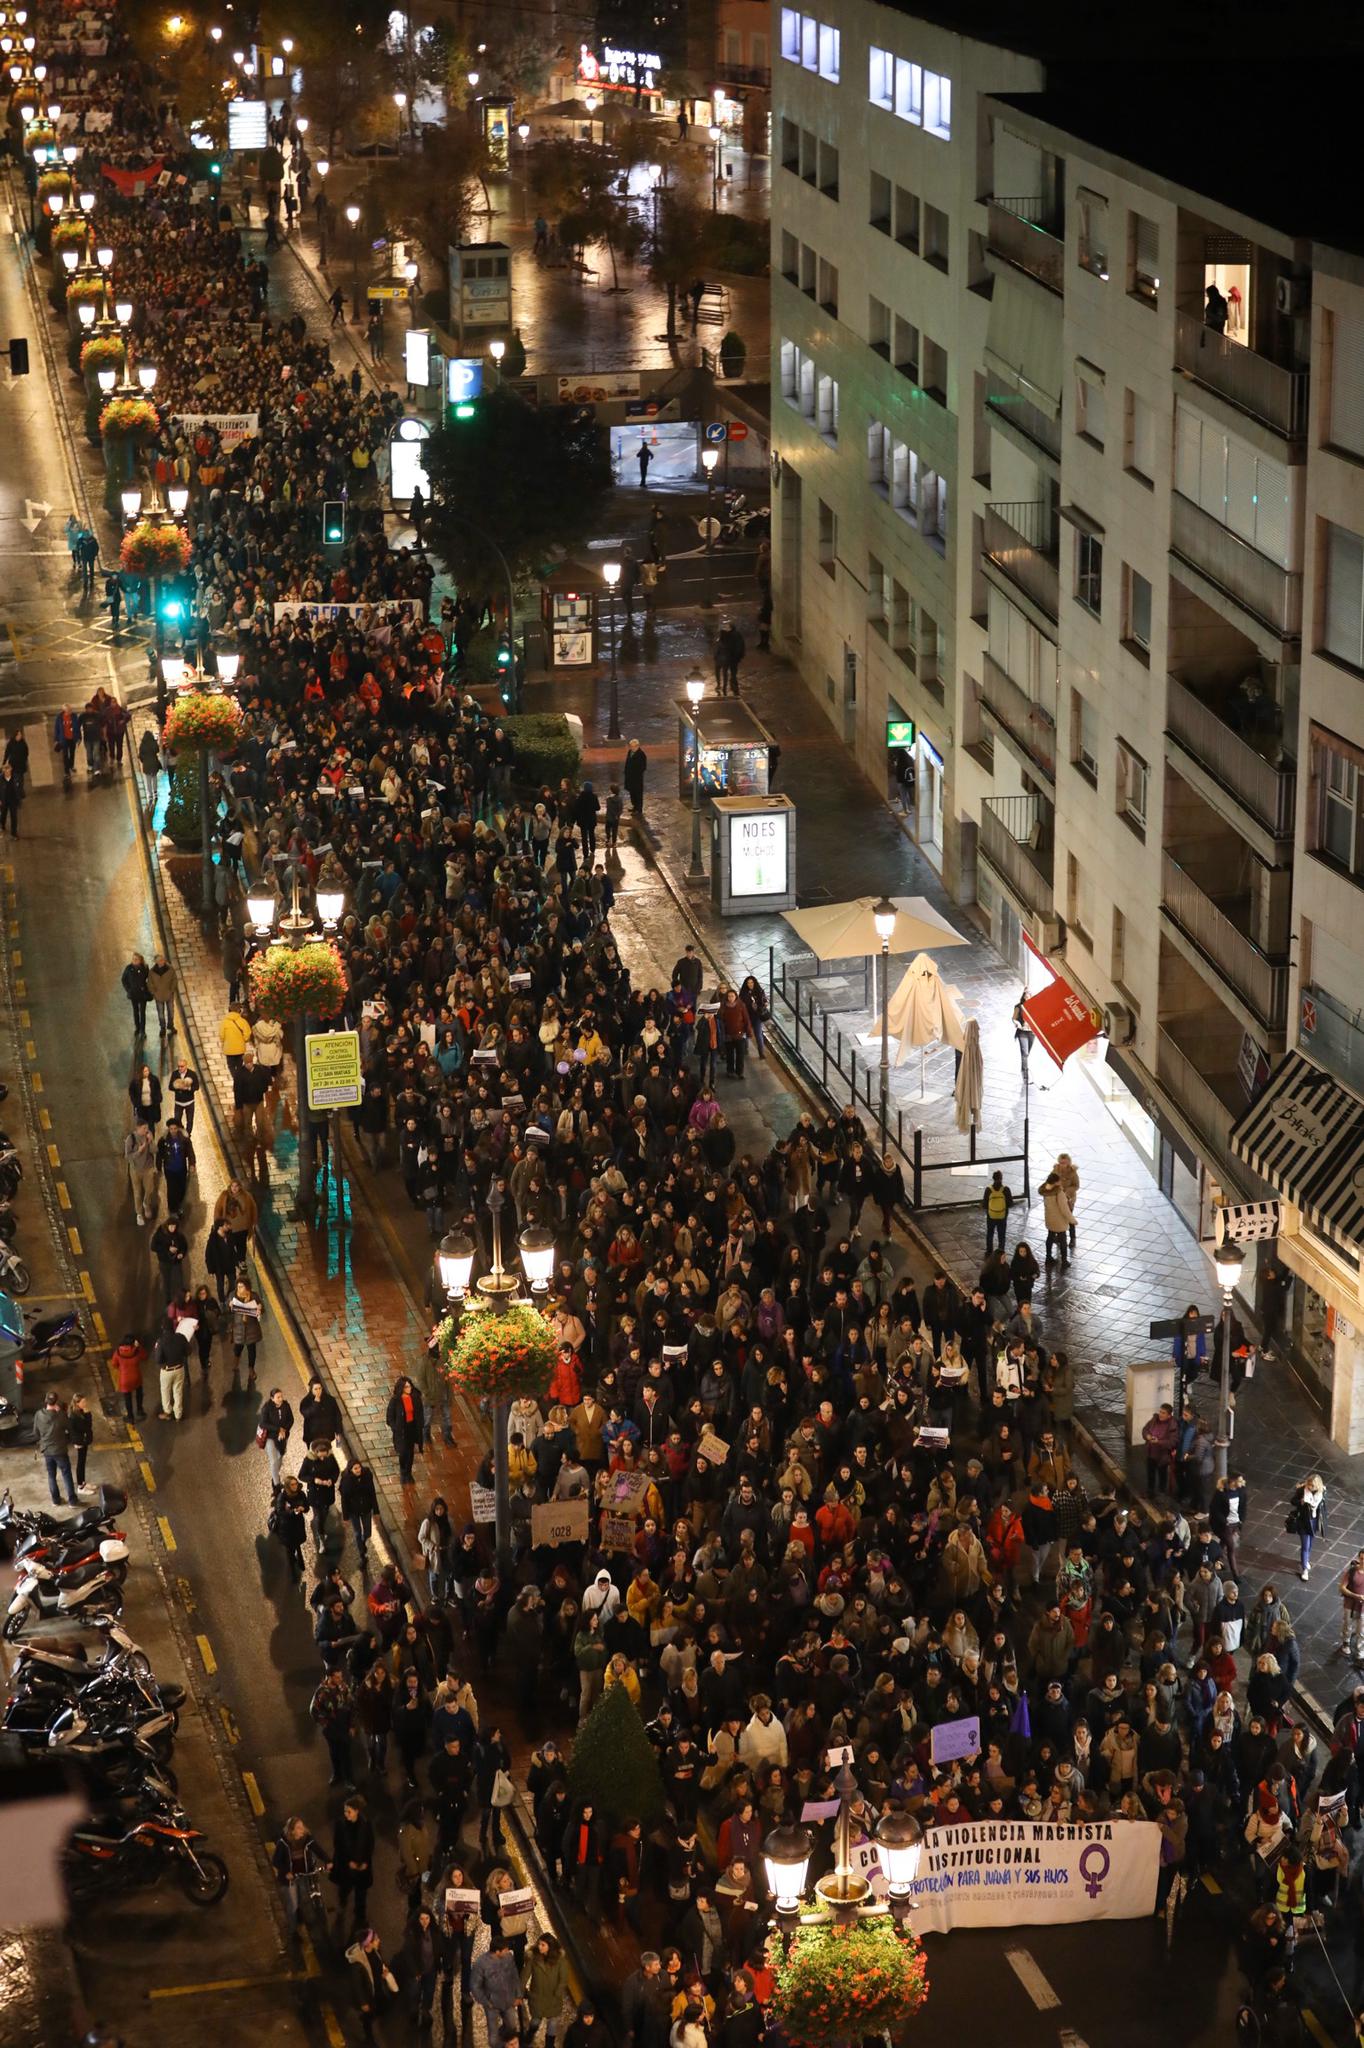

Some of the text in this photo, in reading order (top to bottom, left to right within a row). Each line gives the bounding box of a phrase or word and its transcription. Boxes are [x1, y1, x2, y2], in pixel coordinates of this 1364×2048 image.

[742, 820, 776, 839] NO ES
[551, 1525, 572, 1538] 1028
[923, 1822, 1114, 1850] LA VIOLENCIA MACHISTA
[928, 1847, 1041, 1872] INSTITUCIONAL
[957, 1869, 980, 1887] PARA
[983, 1869, 1012, 1886] JUANA
[1015, 1868, 1022, 1884] Y
[1024, 1868, 1041, 1884] SUS
[1044, 1868, 1069, 1884] HIJOS
